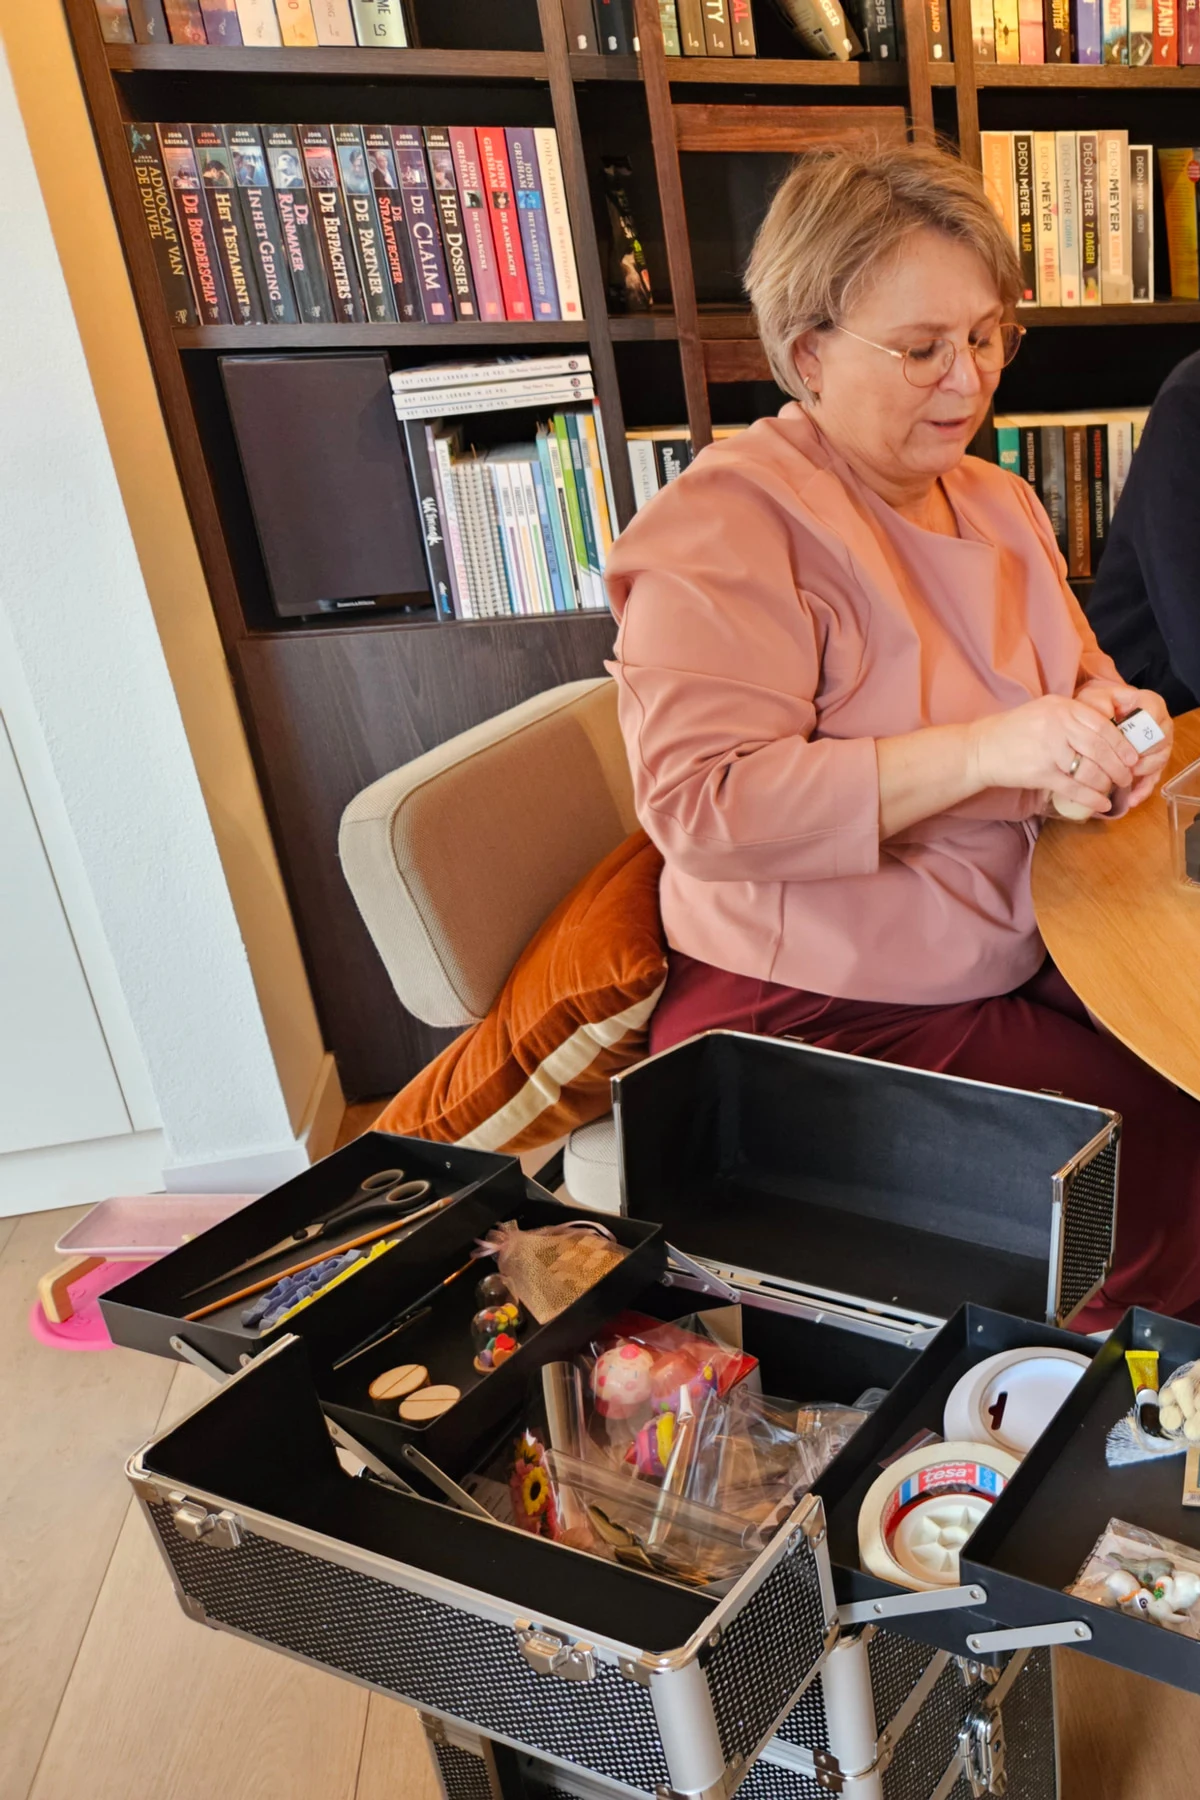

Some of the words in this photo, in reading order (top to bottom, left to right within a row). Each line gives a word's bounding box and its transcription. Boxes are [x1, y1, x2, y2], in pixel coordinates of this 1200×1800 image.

[135, 166, 150, 184] DE
[456, 140, 471, 188] GRISHAM
[467, 161, 479, 188] JOHN
[483, 137, 499, 188] GRISHAM
[495, 160, 507, 189] JOHN
[514, 142, 527, 189] GRISHAM
[1017, 142, 1029, 175] DEON
[1039, 146, 1050, 179] DEON
[1062, 143, 1071, 176] DEON
[1083, 142, 1094, 175] DEON
[1108, 141, 1119, 176] DEON
[1135, 156, 1144, 181] DEON
[524, 163, 536, 189] JOHN
[543, 138, 553, 167] JOHN
[548, 169, 562, 215] GRISHAM
[140, 188, 162, 239] DUIVEL
[182, 194, 199, 214] DE
[215, 193, 233, 222] HET
[248, 189, 262, 208] IN
[318, 192, 336, 213] DE
[353, 199, 369, 223] DE
[410, 195, 425, 215] DE
[439, 194, 458, 227] HET
[1018, 178, 1031, 216] MEYER
[1041, 181, 1052, 232] MEYER
[1063, 179, 1072, 215] MEYER
[1084, 178, 1094, 217] MEYER
[1109, 179, 1120, 232] MEYER
[1136, 183, 1144, 211] MEYER
[149, 166, 177, 242] ADVOCAAT
[168, 246, 185, 276] VAN
[252, 210, 269, 240] HET
[294, 204, 309, 225] DE
[391, 206, 403, 222] DE
[472, 211, 480, 222] DE
[500, 212, 508, 222] DE
[1021, 222, 1032, 234] 13
[278, 193, 304, 272] RAINMAKER
[378, 196, 404, 285] STRAATVECHTER
[473, 222, 487, 270] GEVANGENE
[1085, 231, 1095, 264] DAGEN
[187, 218, 218, 304] BROEDERSCHAP
[222, 226, 250, 305] TESTAMENT
[323, 217, 351, 300] ERFPACHTERS
[358, 228, 384, 296] PARTNER
[413, 222, 441, 291] CLAIM
[447, 233, 470, 295] DOSSIER
[501, 222, 517, 277] AANKLACHT
[1044, 247, 1055, 283] ICARUS
[259, 241, 281, 300] GEDING
[637, 449, 649, 474] JOHN
[923, 1468, 967, 1483] tesa
